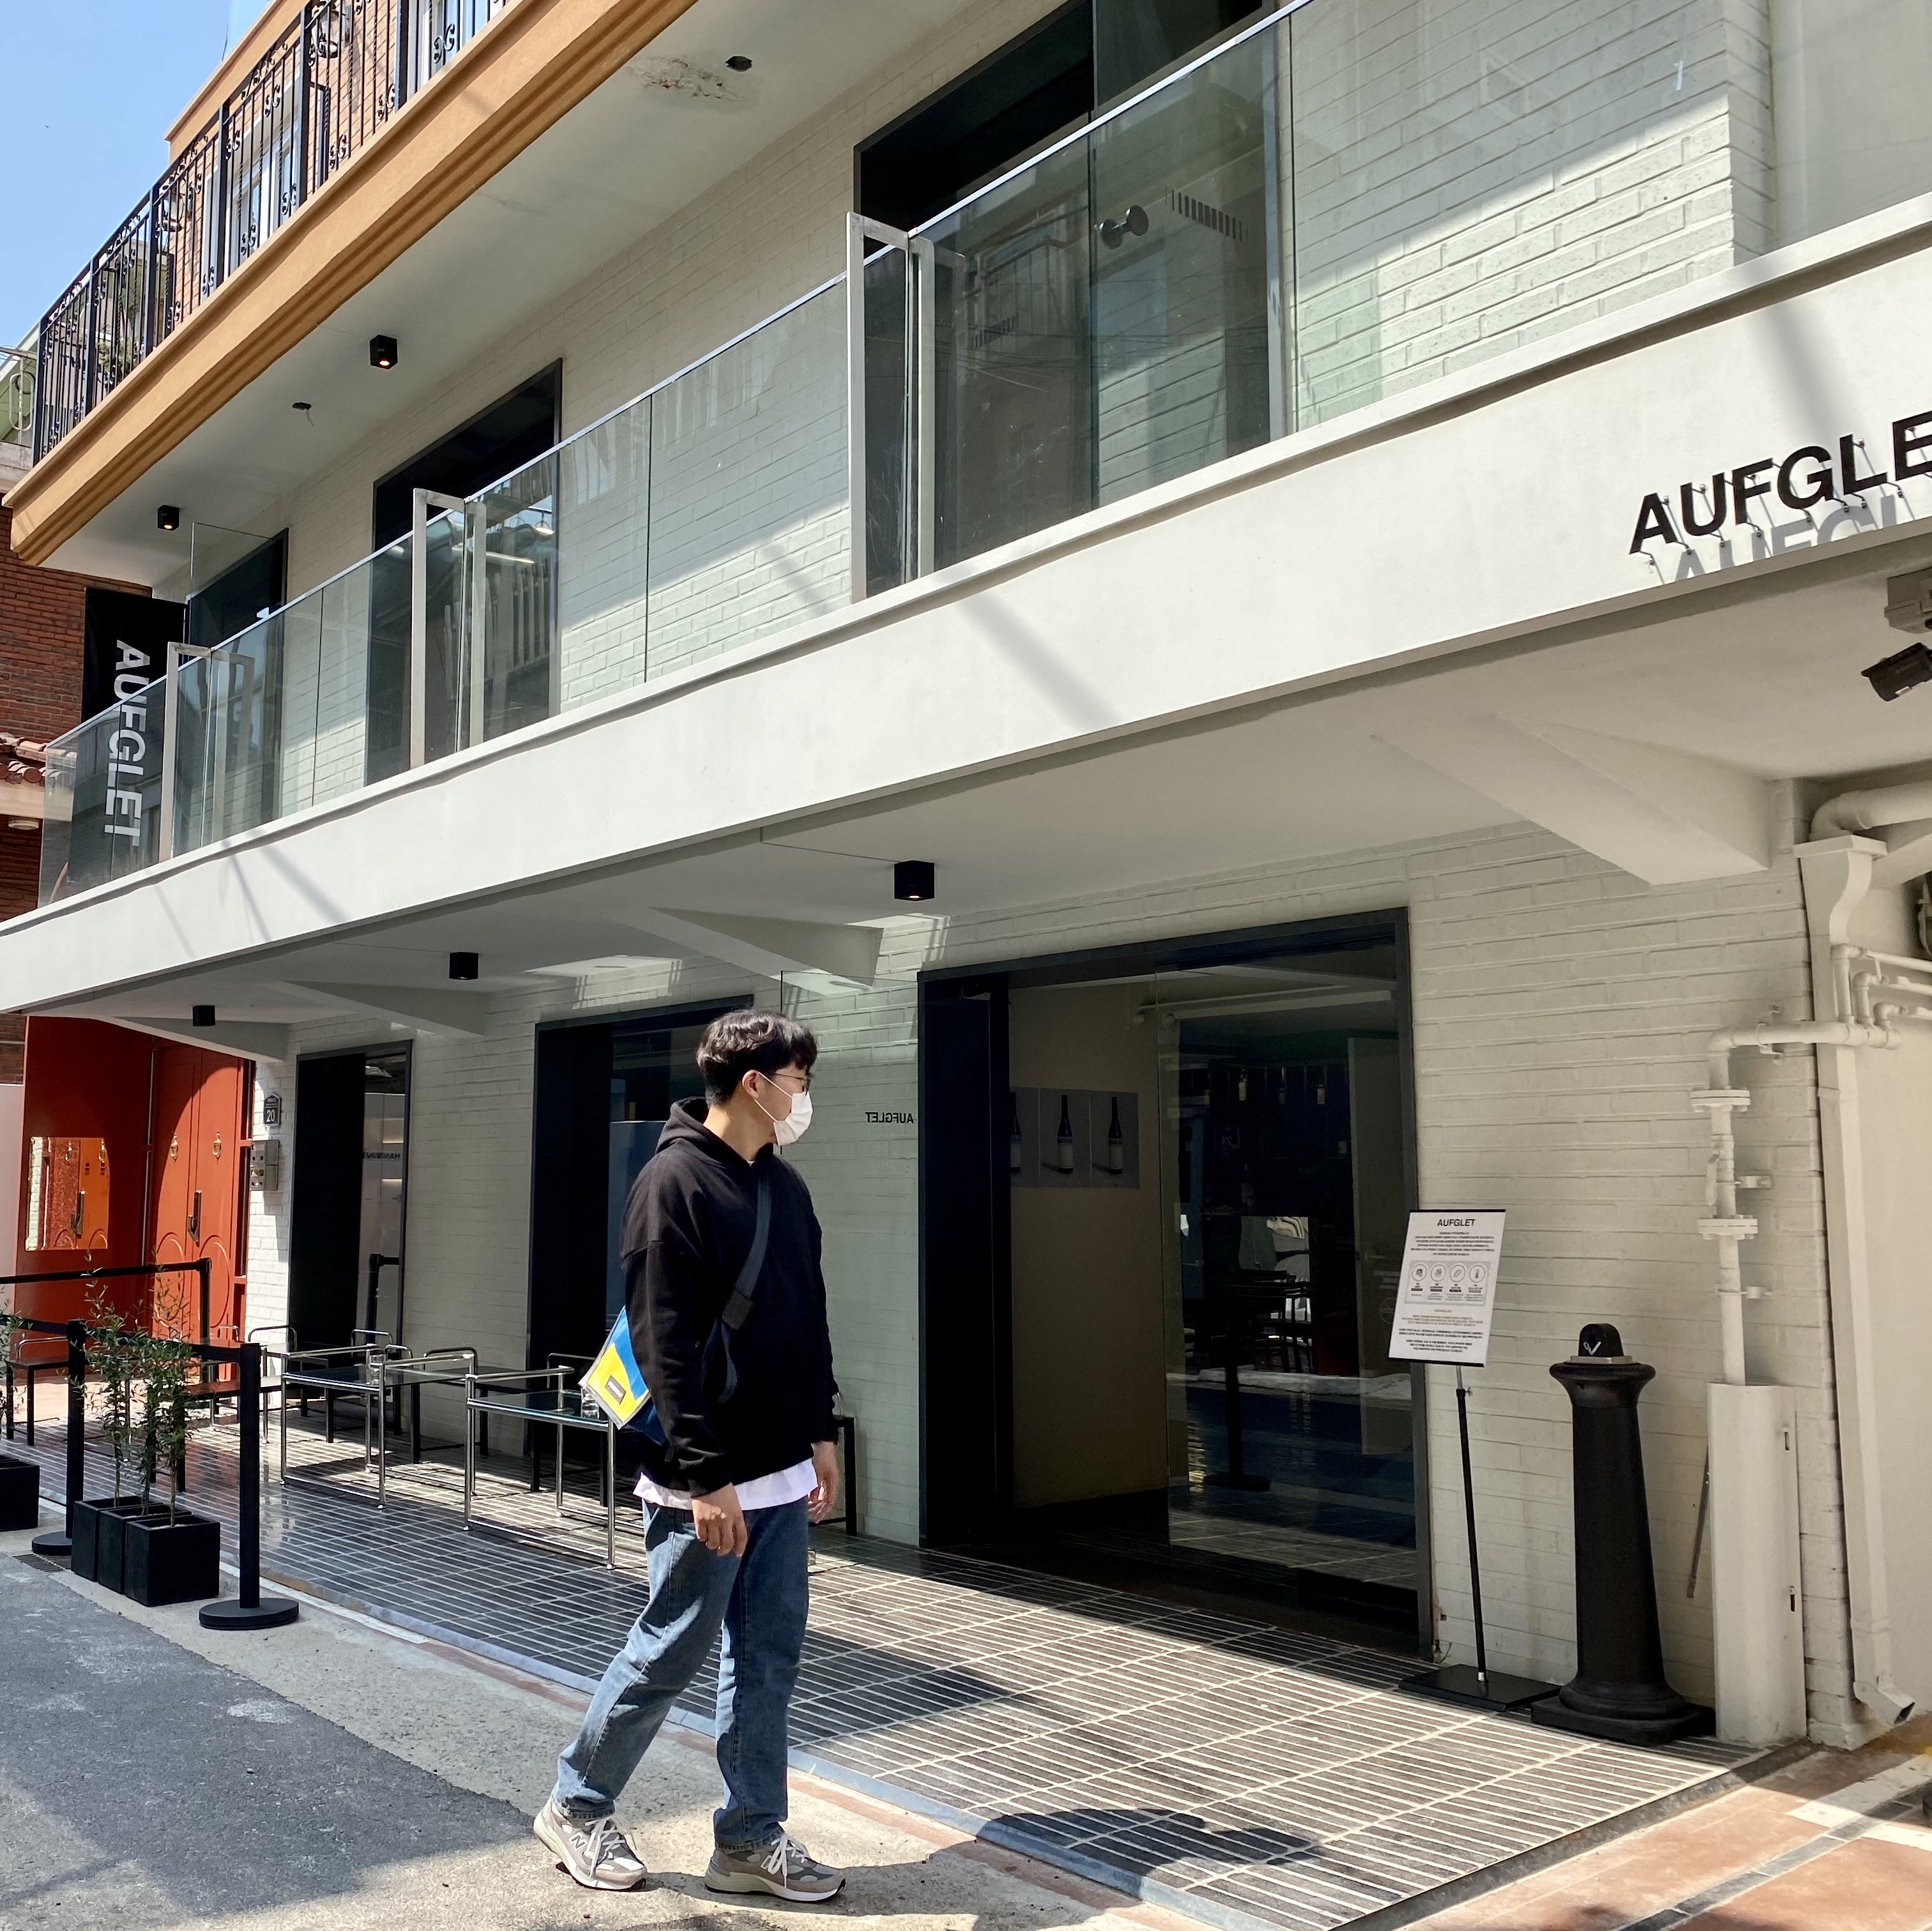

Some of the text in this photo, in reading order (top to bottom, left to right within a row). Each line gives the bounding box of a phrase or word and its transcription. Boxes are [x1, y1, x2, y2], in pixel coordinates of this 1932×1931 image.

[104, 639, 151, 847] AUFGLET
[266, 1109, 275, 1123] 20
[1436, 1218, 1477, 1227] AUFGLET
